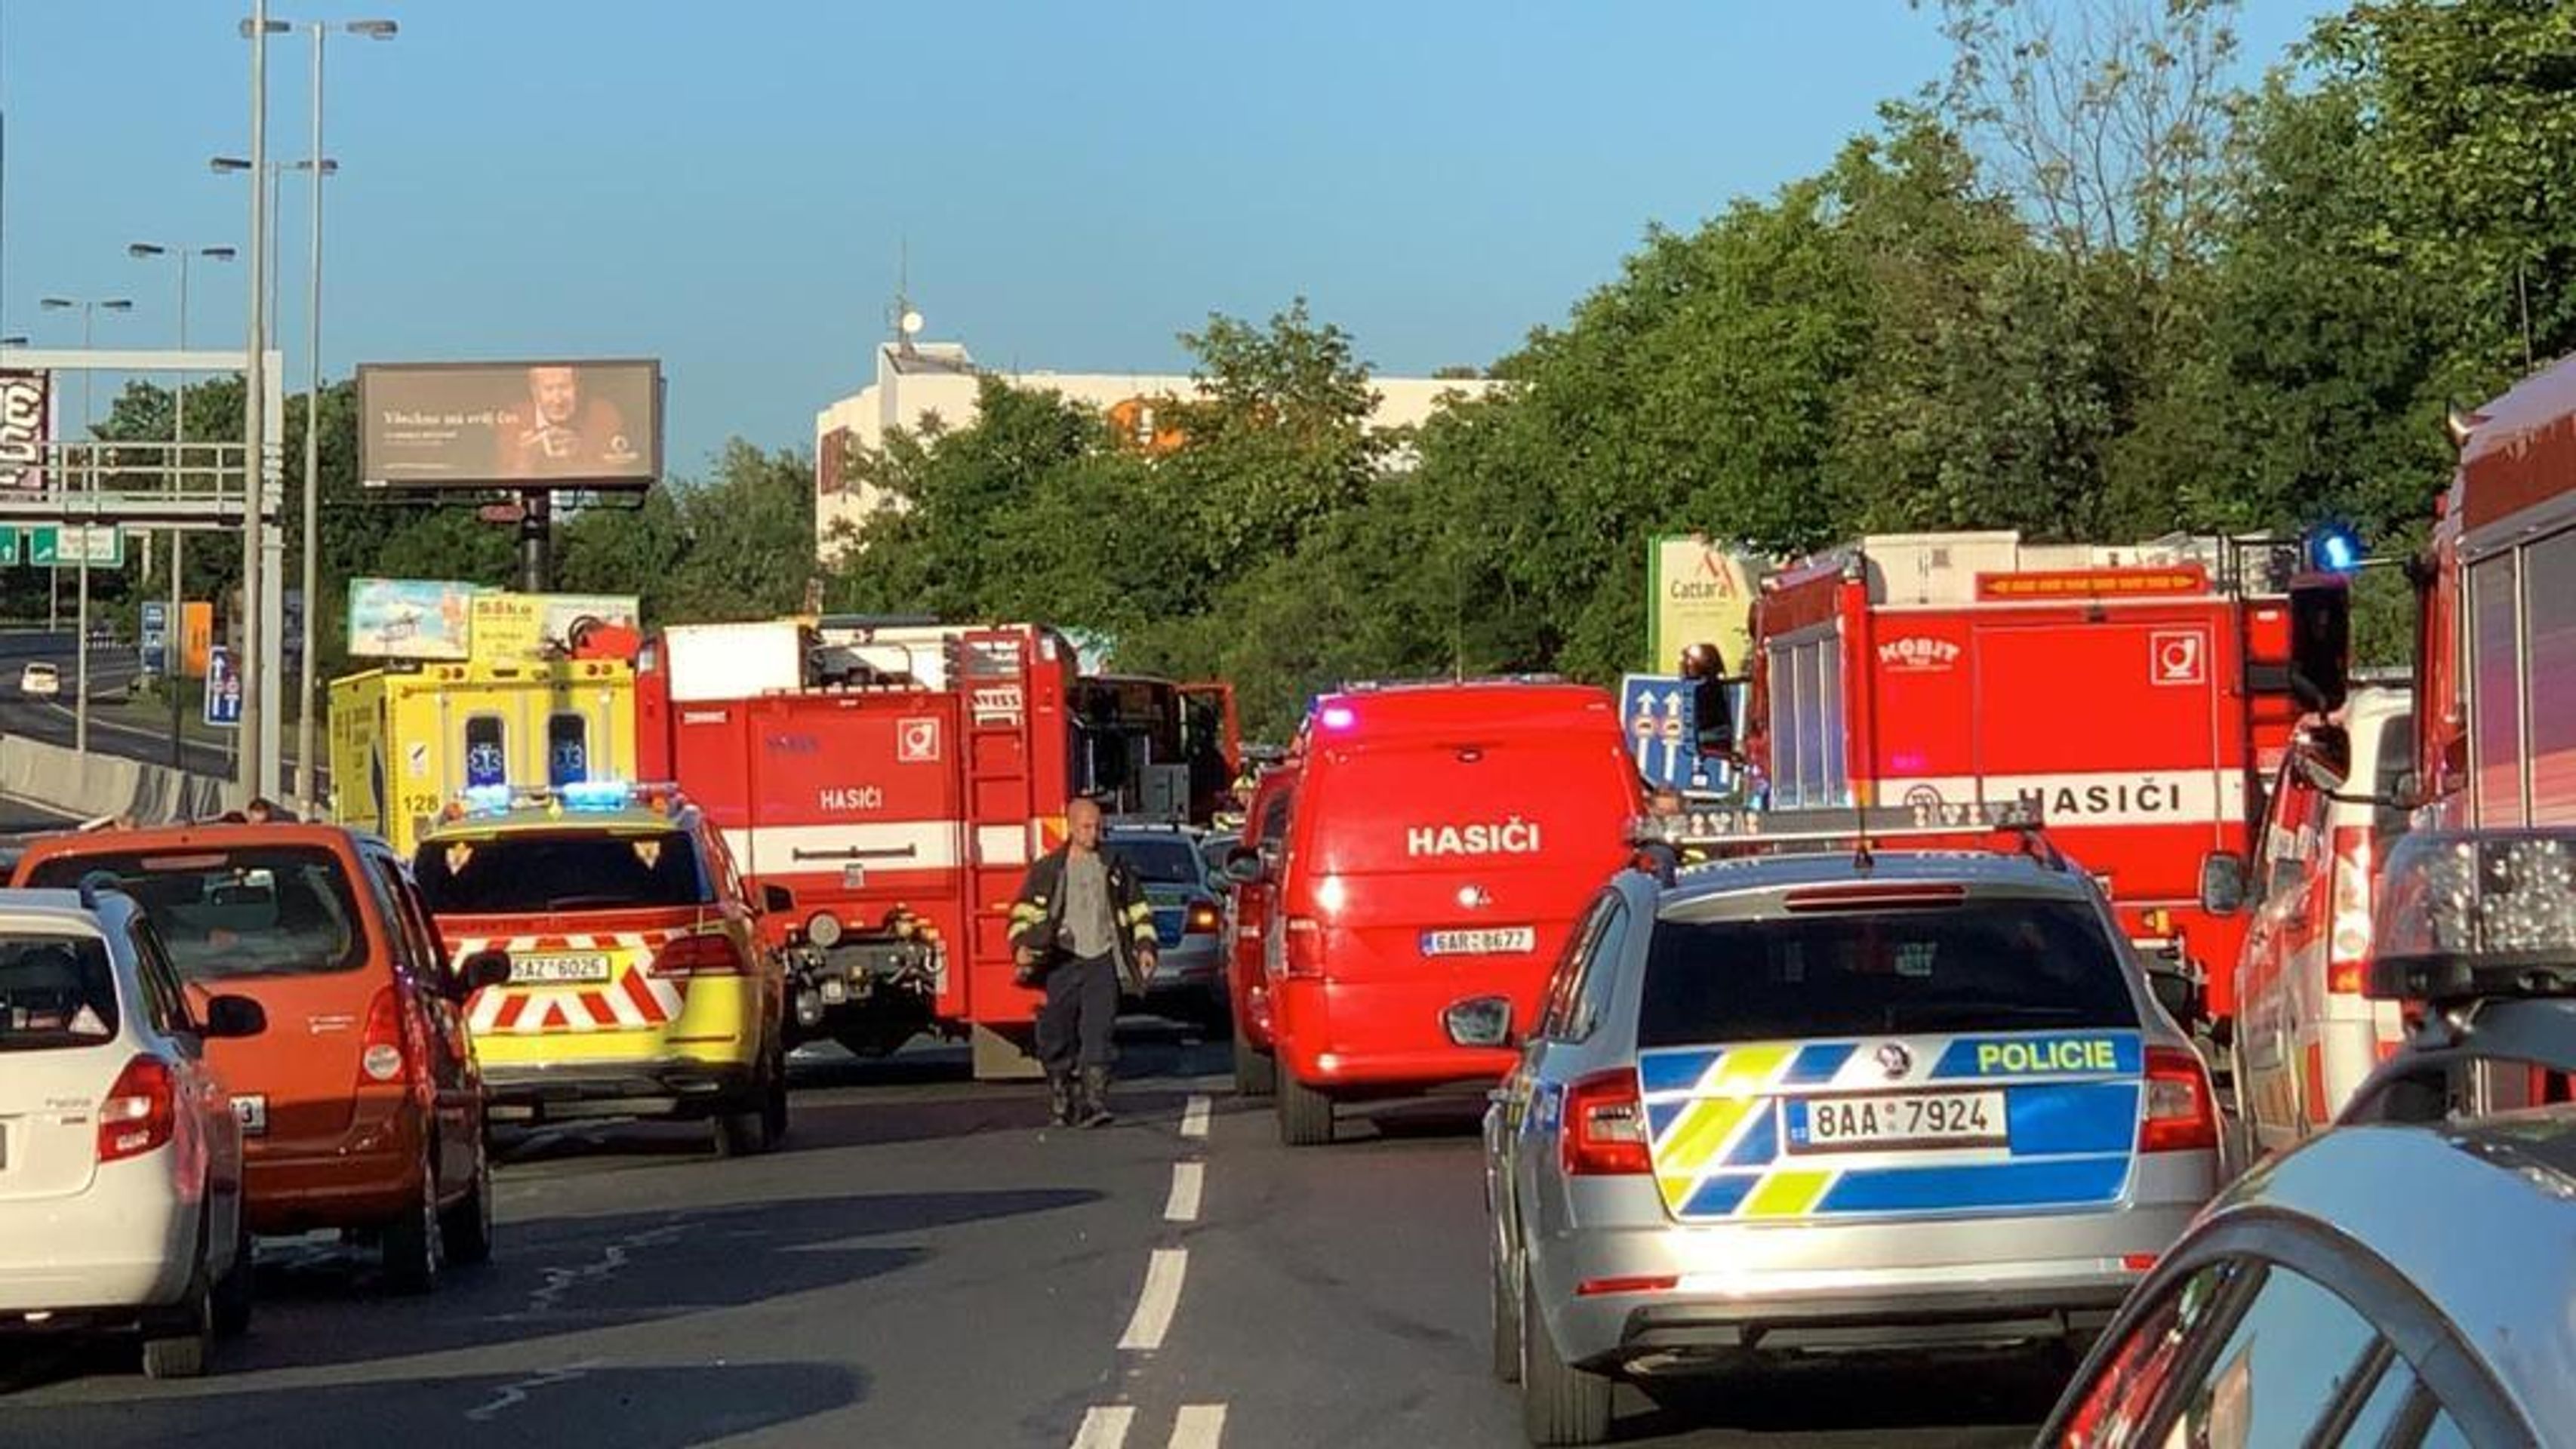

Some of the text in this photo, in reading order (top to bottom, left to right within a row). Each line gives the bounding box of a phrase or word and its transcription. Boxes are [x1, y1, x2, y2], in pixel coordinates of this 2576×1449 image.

[404, 794, 439, 814] 128
[820, 786, 882, 811] HASIČI
[1408, 815, 1539, 856] HASIČI
[1977, 1041, 2117, 1073] POLICIE
[1817, 1097, 1989, 1138] 8AA 7924
